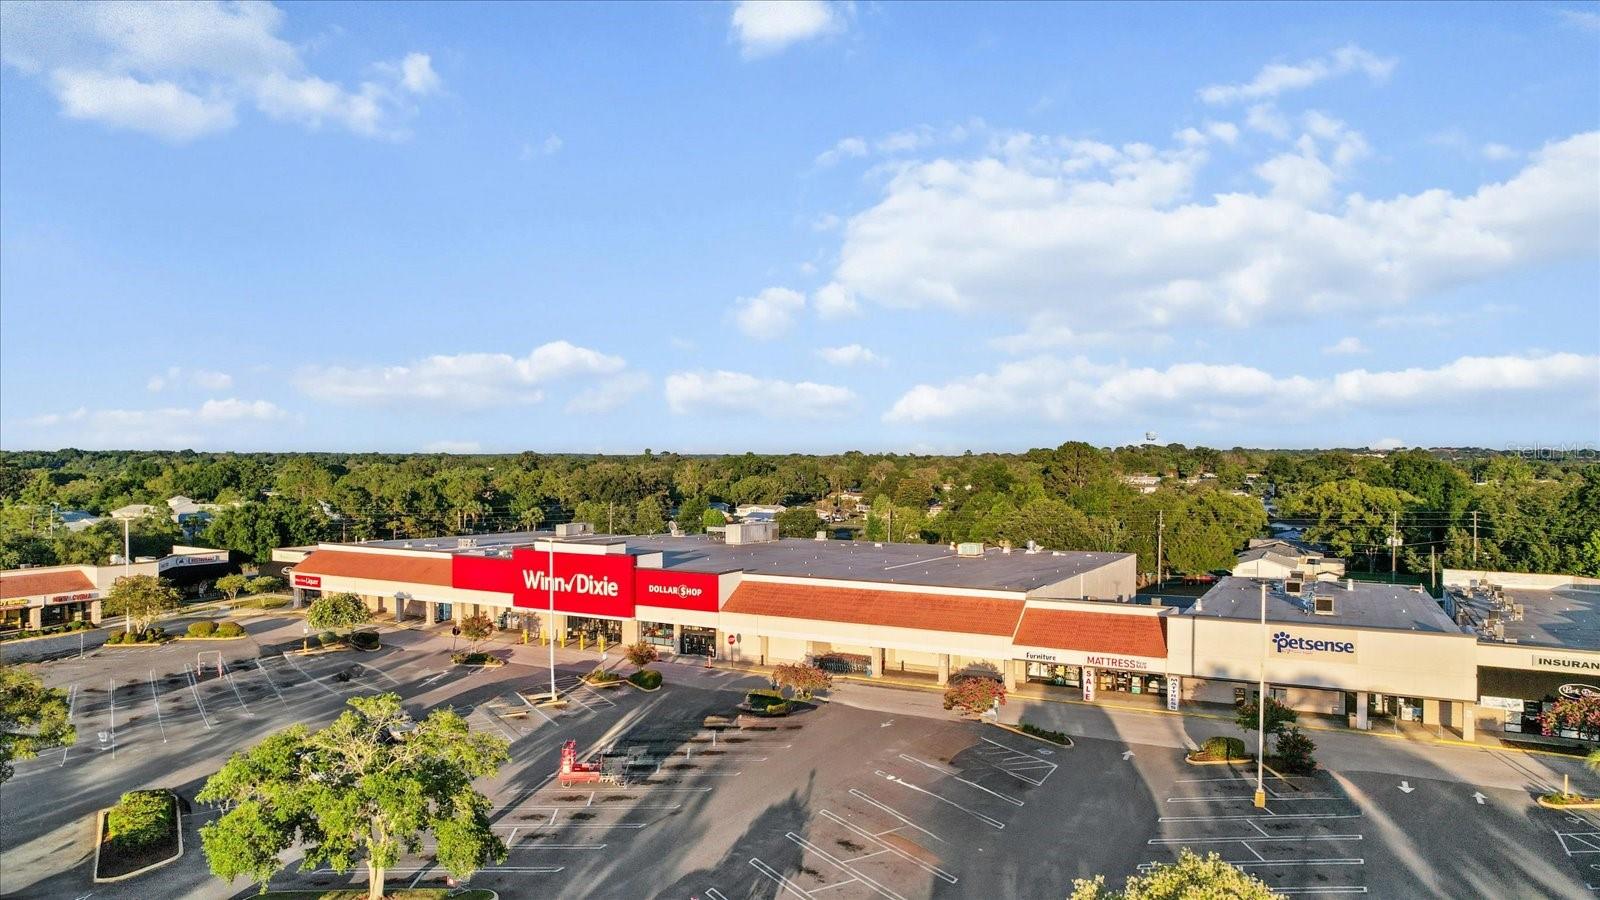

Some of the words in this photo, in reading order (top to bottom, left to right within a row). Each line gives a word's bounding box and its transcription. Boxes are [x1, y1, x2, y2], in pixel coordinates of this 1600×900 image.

[522, 569, 565, 592] Winn
[576, 573, 618, 597] Dixie
[648, 584, 678, 595] DOLLAR
[1276, 637, 1355, 655] petsense
[1026, 652, 1057, 662] Furniture
[1087, 656, 1136, 669] MATTRESS
[1085, 670, 1093, 701] SALE
